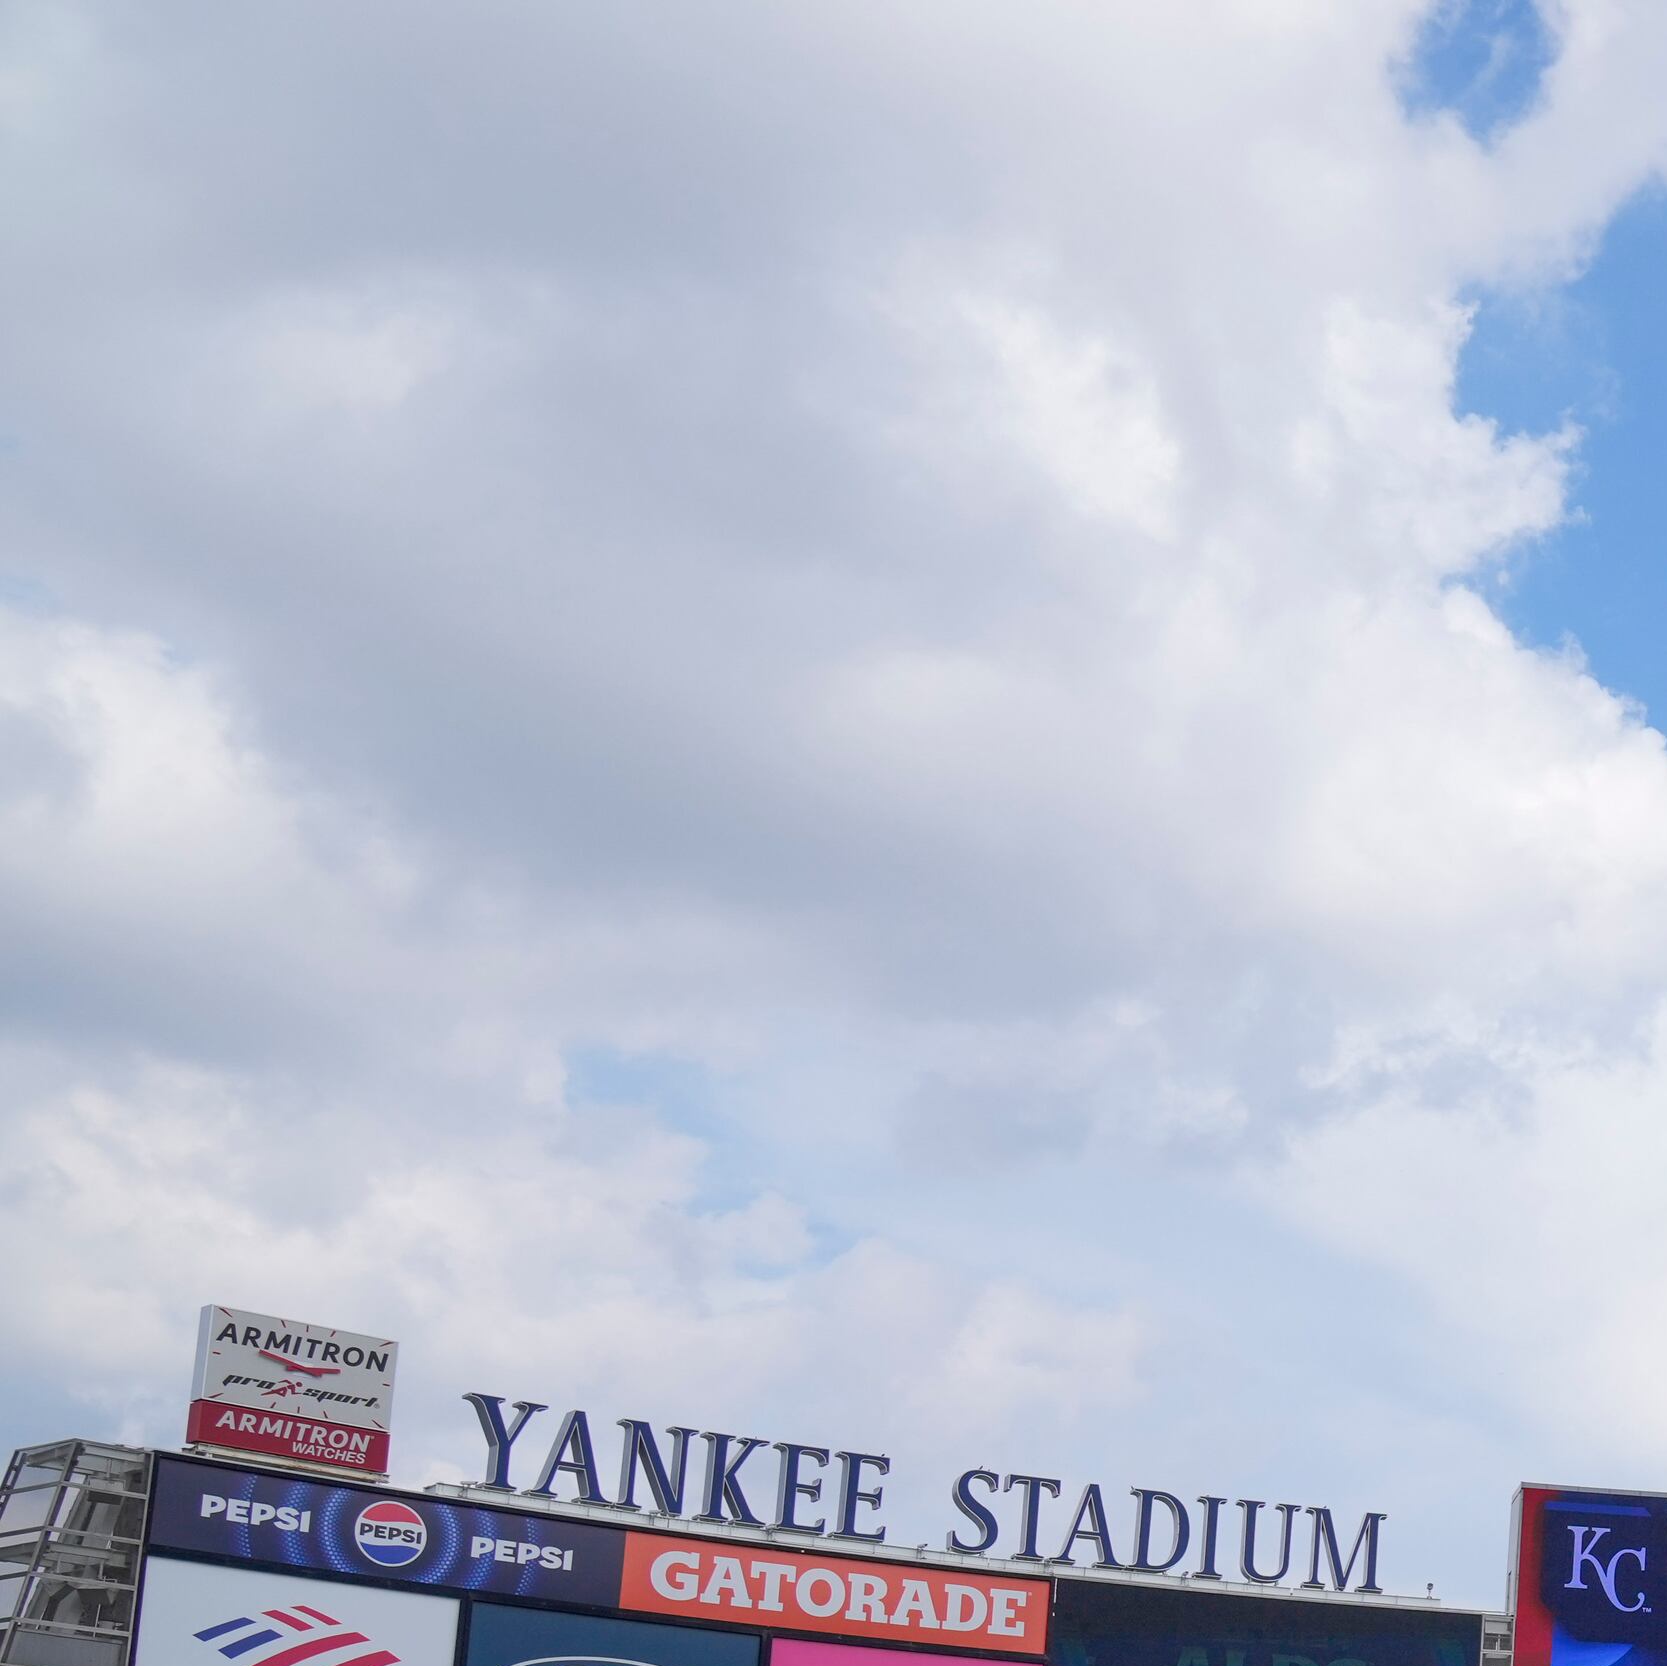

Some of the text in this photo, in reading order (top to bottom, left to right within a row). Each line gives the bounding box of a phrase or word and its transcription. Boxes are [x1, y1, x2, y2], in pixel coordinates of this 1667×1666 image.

[216, 1323, 389, 1372] ARMITRON
[222, 1375, 378, 1407] pro sport
[216, 1410, 370, 1453] ARMITRON
[292, 1441, 366, 1464] WATCHES
[461, 1391, 1388, 1595] YANKEE STADIUM
[200, 1494, 573, 1571] PEPSI PEPSI PEPSI
[650, 1550, 1028, 1638] GATORADE
